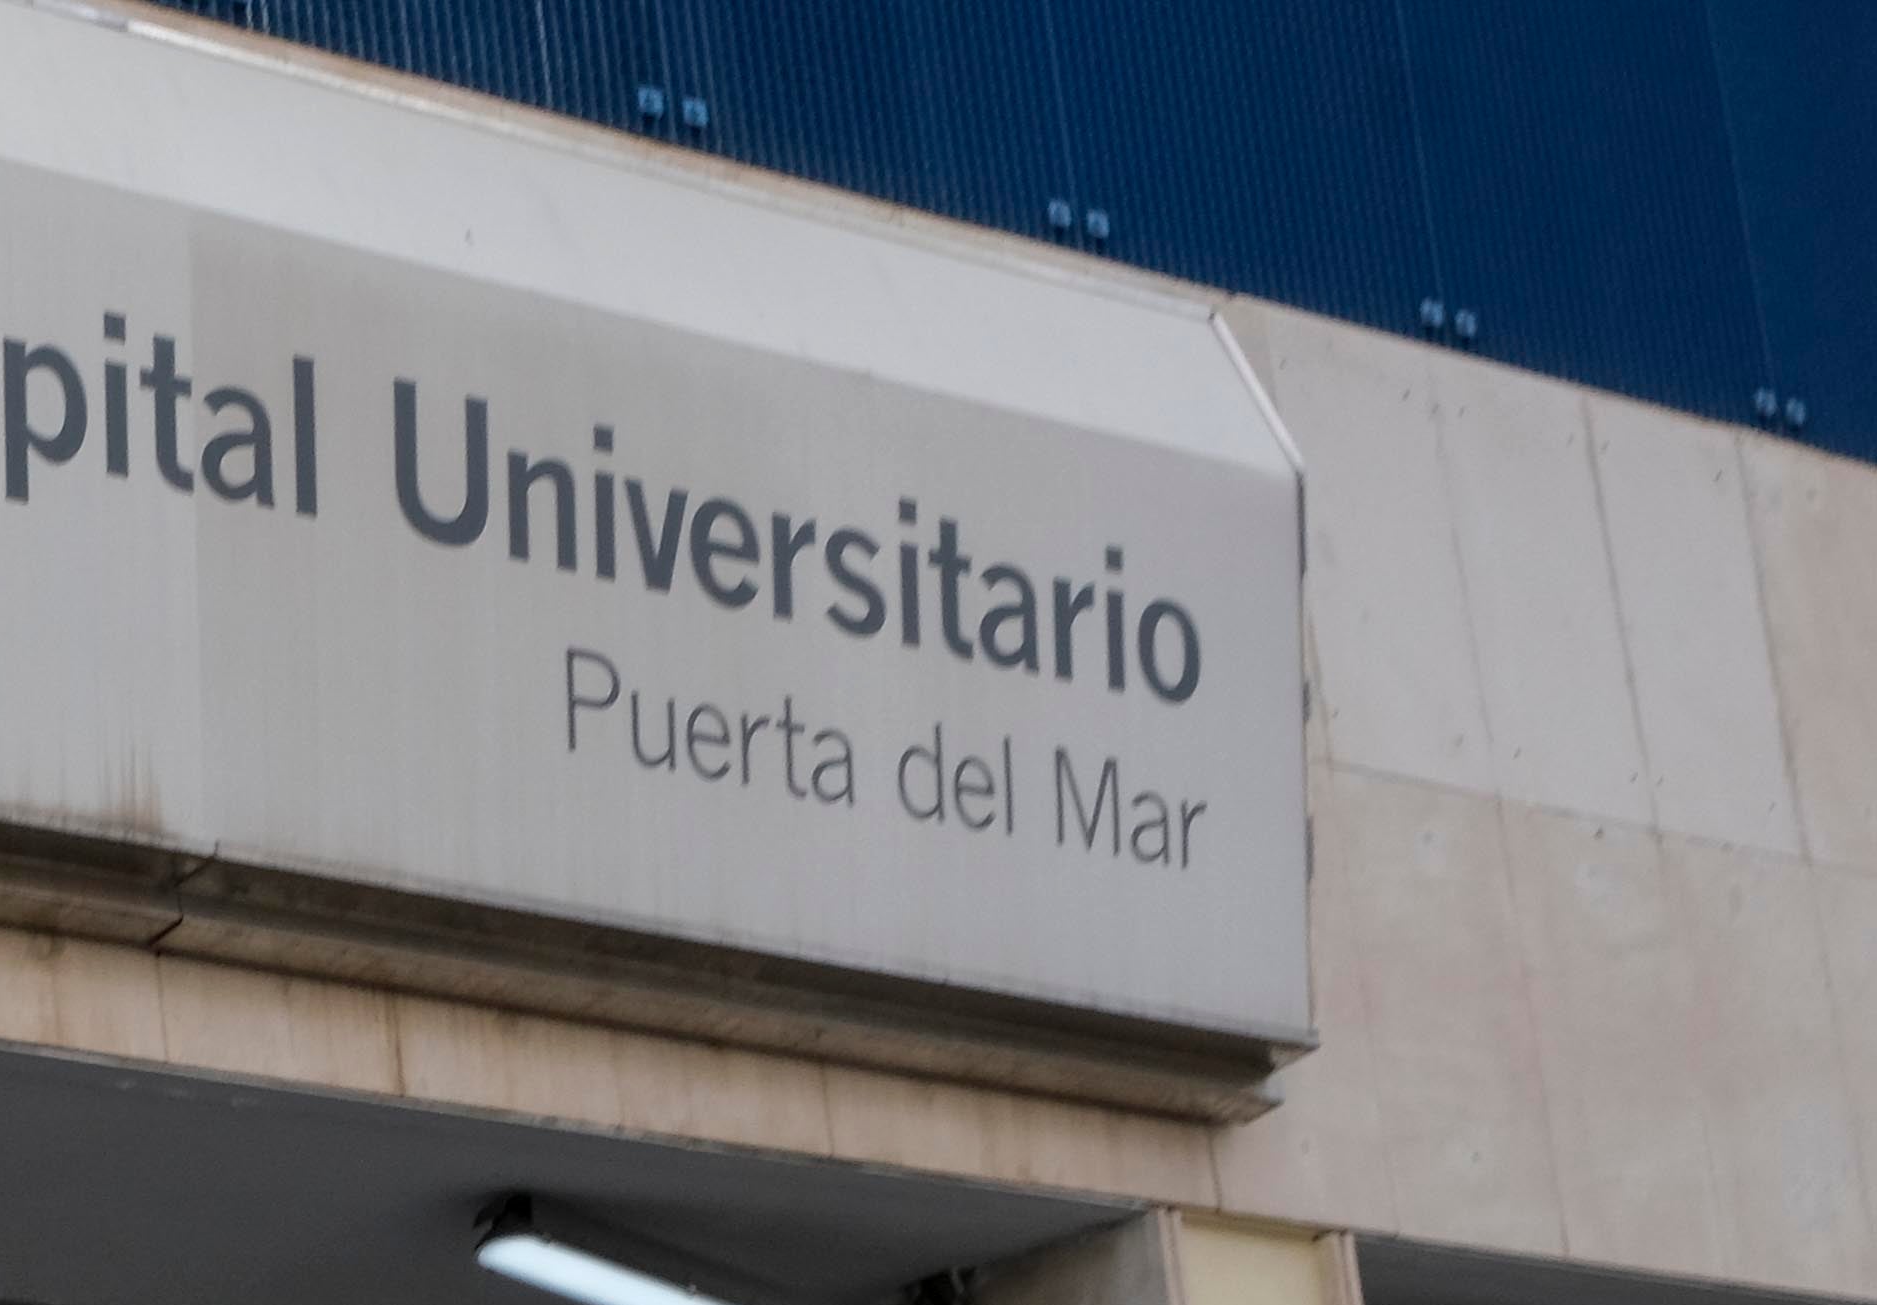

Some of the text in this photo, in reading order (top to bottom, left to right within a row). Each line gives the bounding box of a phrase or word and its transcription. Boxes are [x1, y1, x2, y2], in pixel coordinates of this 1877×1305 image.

[393, 377, 1203, 706] Universitario
[564, 646, 1207, 870] Puerta del Mar
